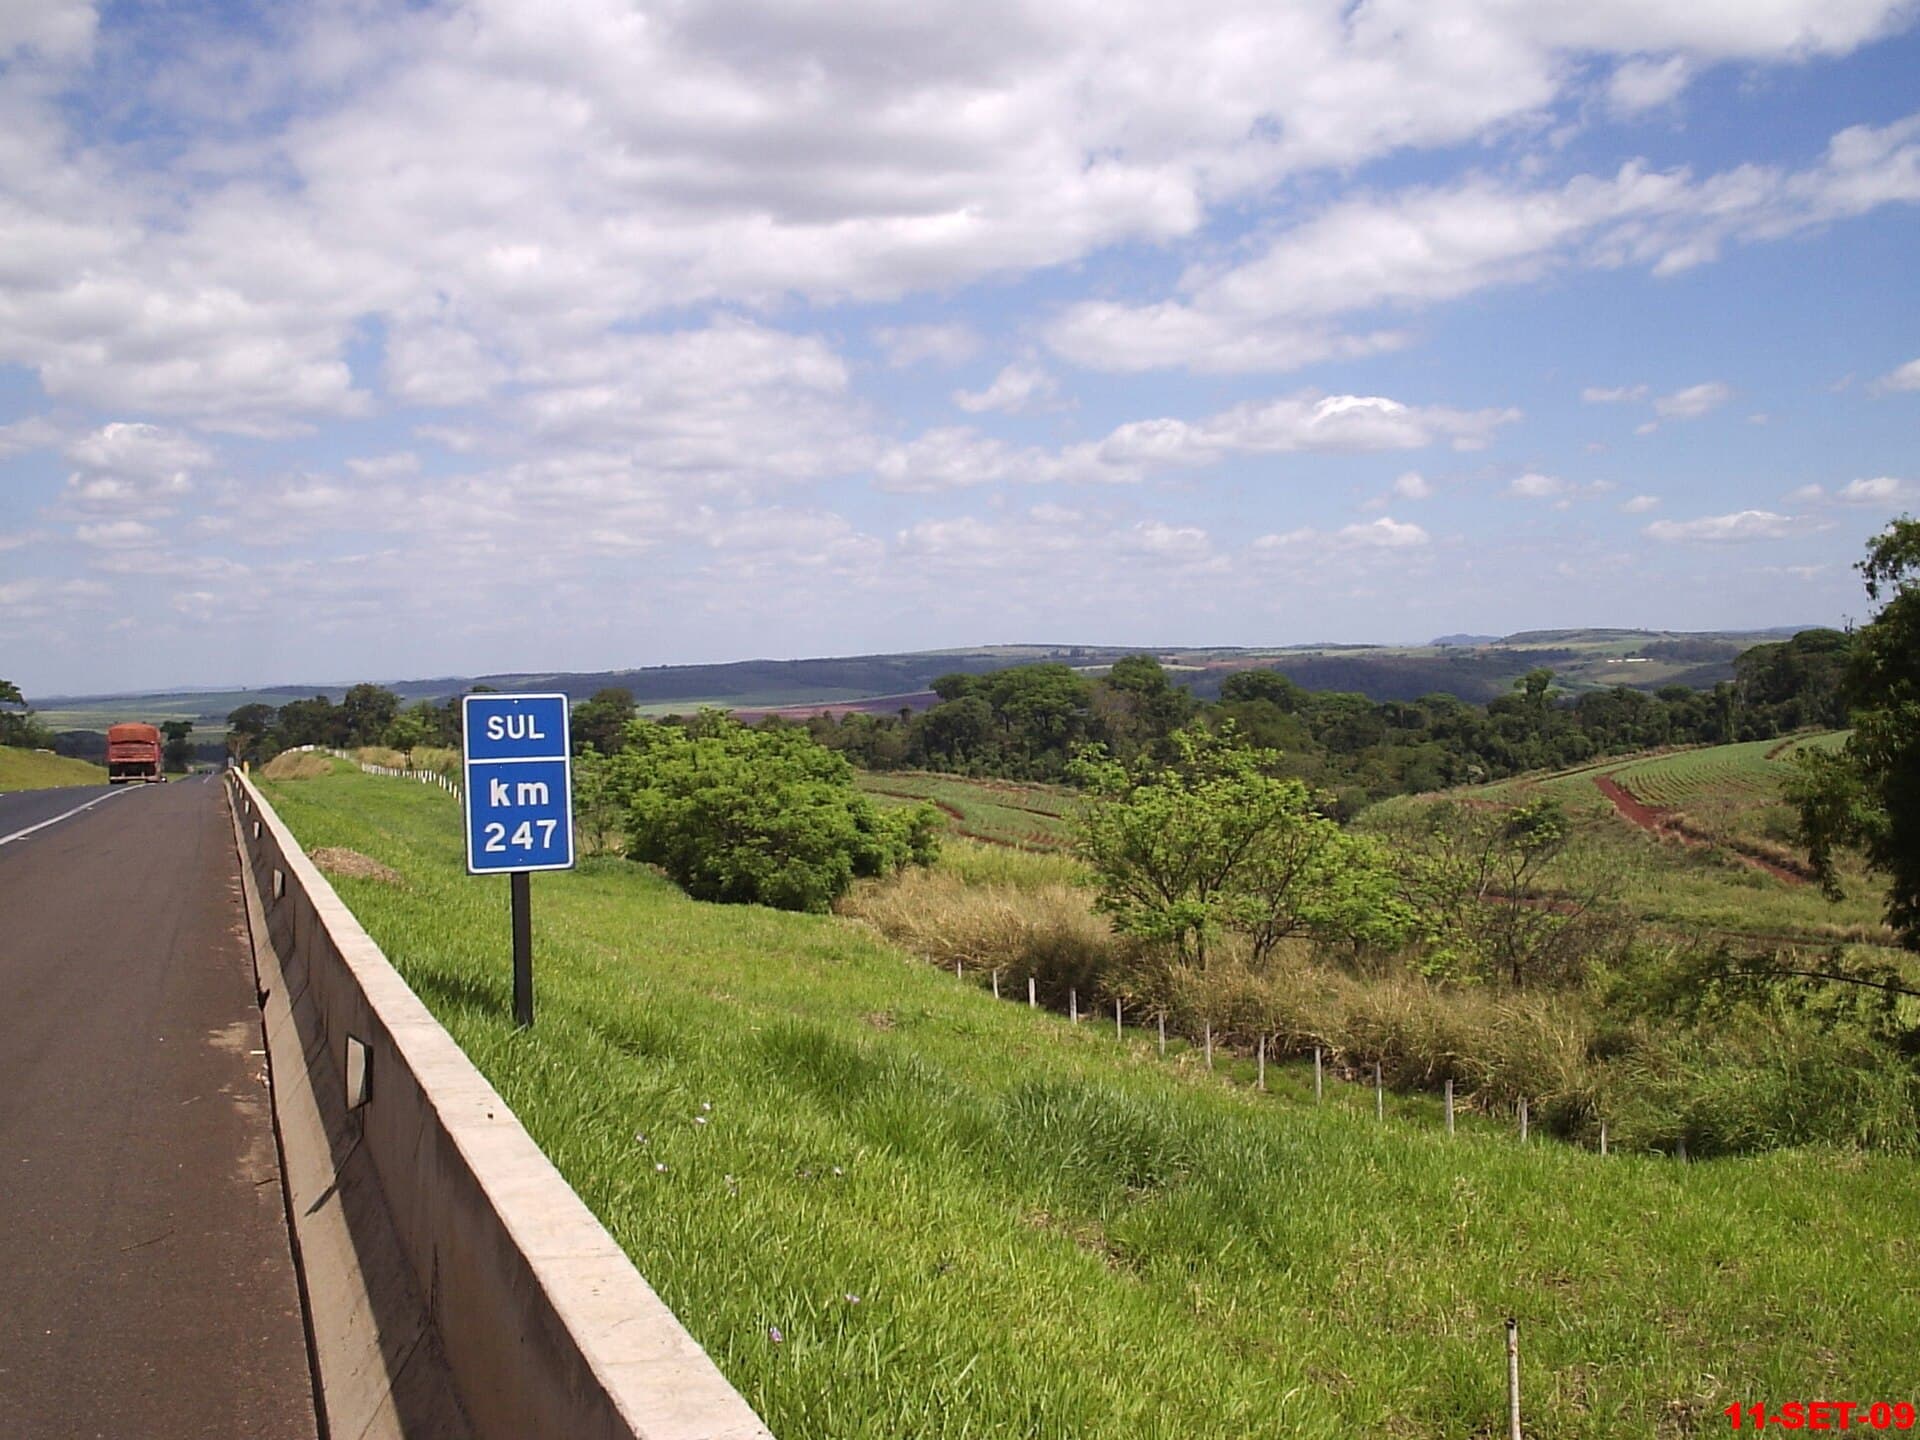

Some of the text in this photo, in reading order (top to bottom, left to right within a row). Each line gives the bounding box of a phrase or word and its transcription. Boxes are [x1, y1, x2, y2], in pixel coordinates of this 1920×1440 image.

[486, 714, 545, 740] SUL
[489, 778, 550, 807] km
[484, 819, 557, 853] 247
